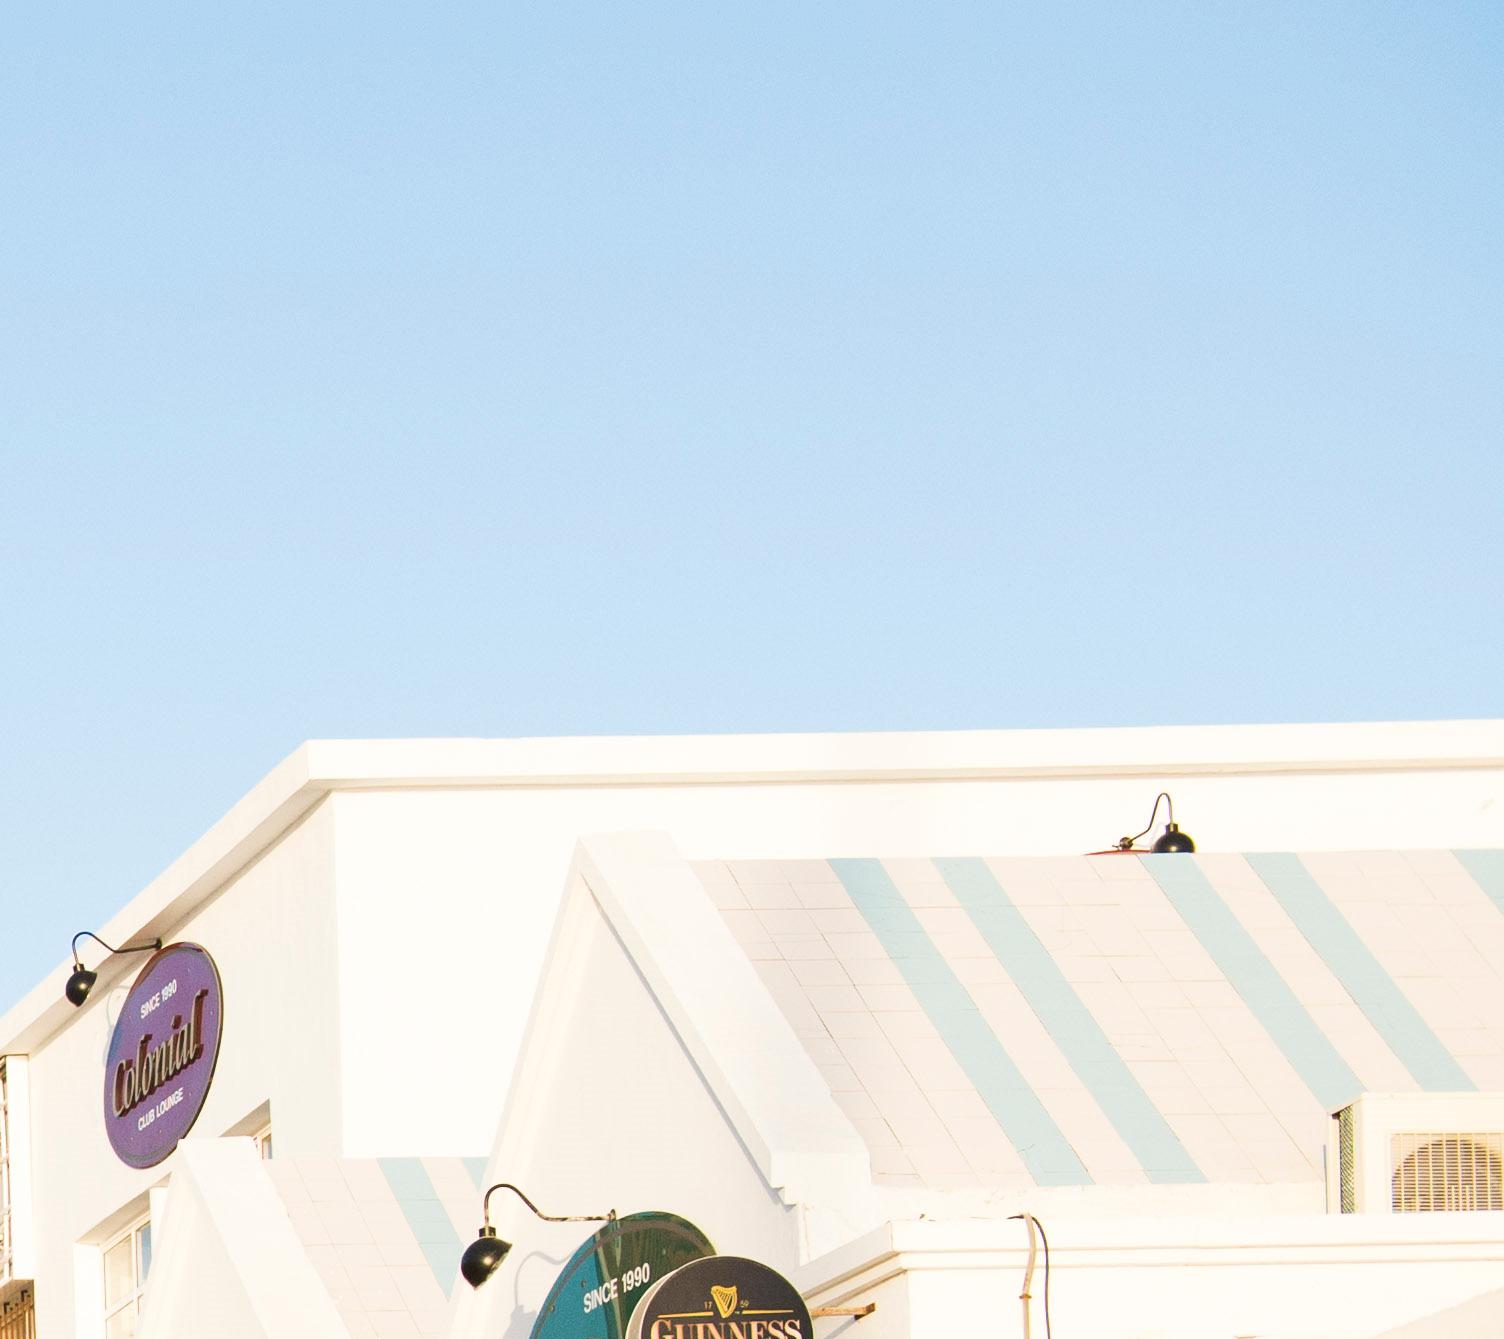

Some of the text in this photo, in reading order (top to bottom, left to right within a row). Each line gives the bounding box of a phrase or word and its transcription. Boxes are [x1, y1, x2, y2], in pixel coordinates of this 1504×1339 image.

[140, 979, 177, 1019] SINCE 1990
[112, 988, 208, 1118] Colonial
[138, 1087, 184, 1131] CLUB LOUNGE
[583, 1262, 651, 1314] SINCE 1990
